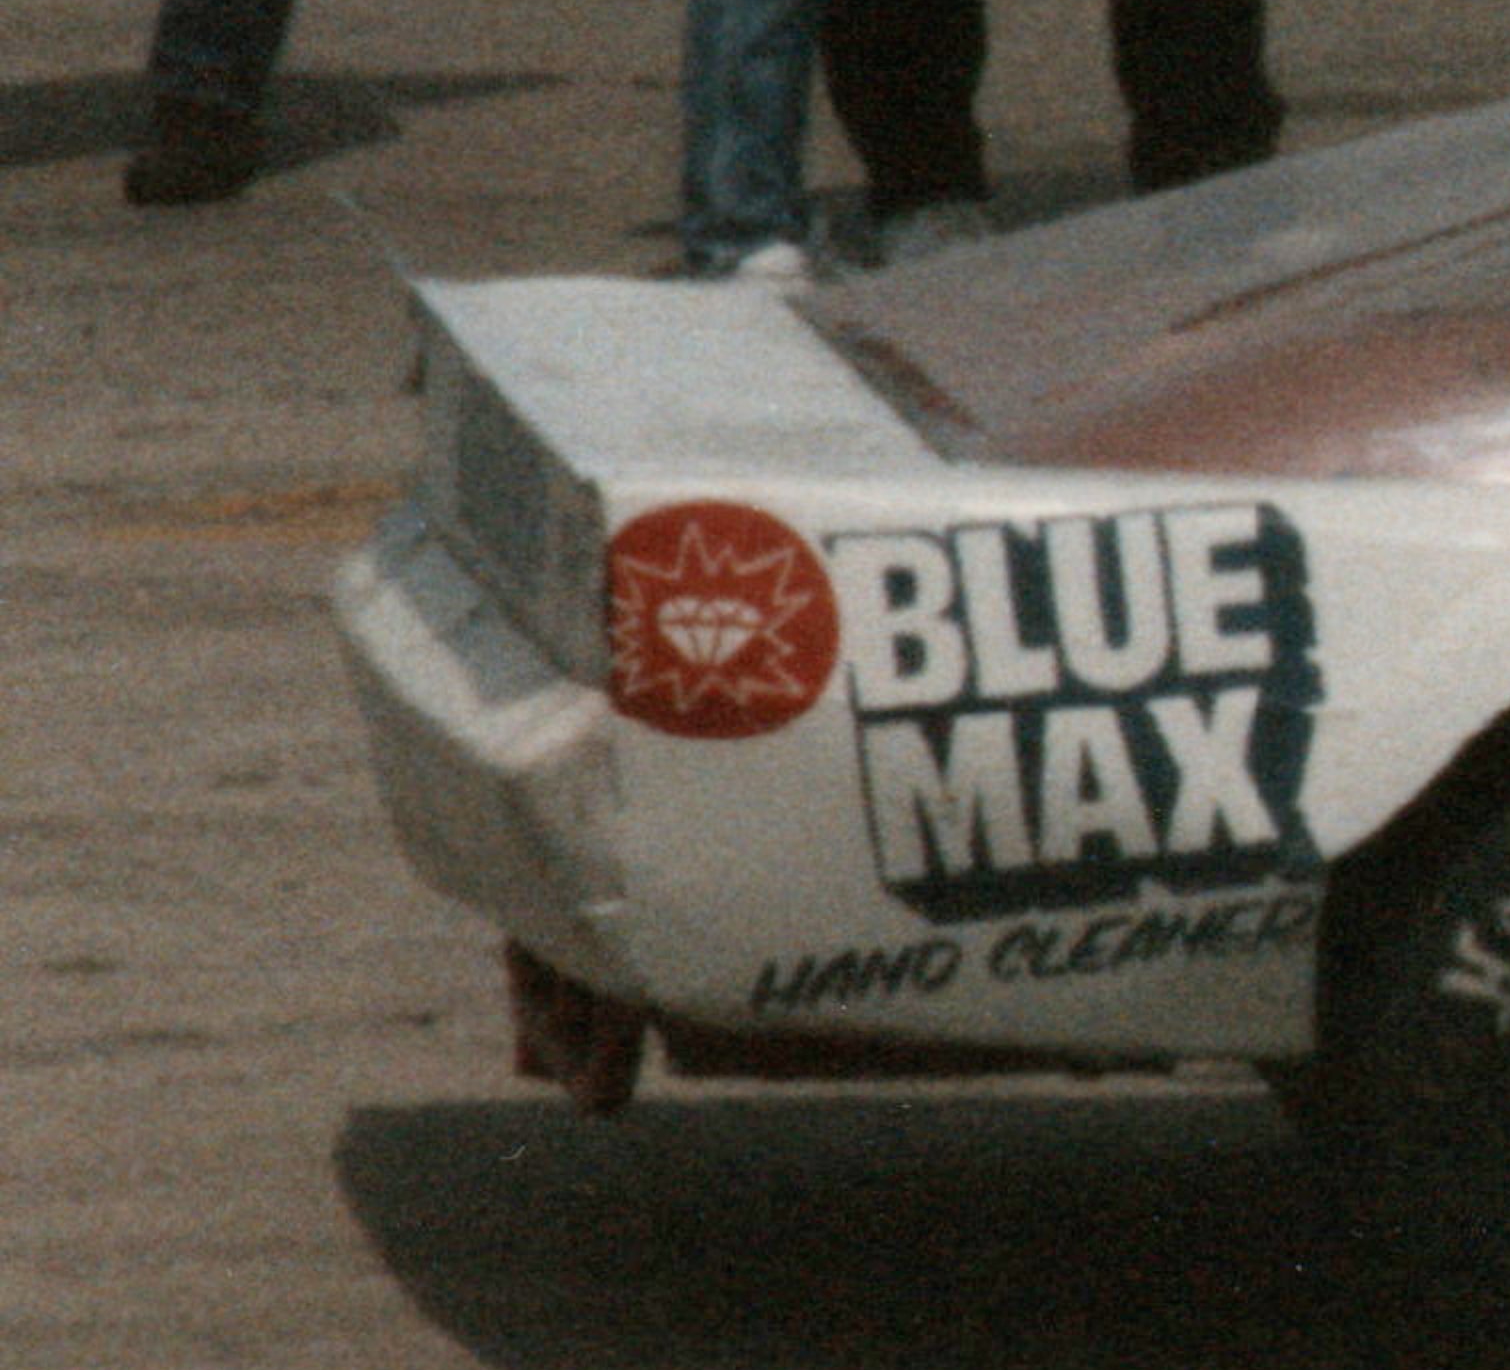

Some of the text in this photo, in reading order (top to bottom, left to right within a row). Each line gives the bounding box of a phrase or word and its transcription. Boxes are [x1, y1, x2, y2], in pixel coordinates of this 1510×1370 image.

[833, 503, 1300, 713] BLUE
[858, 686, 1290, 889] MAX
[749, 897, 1316, 1015] HAND CLEANER
